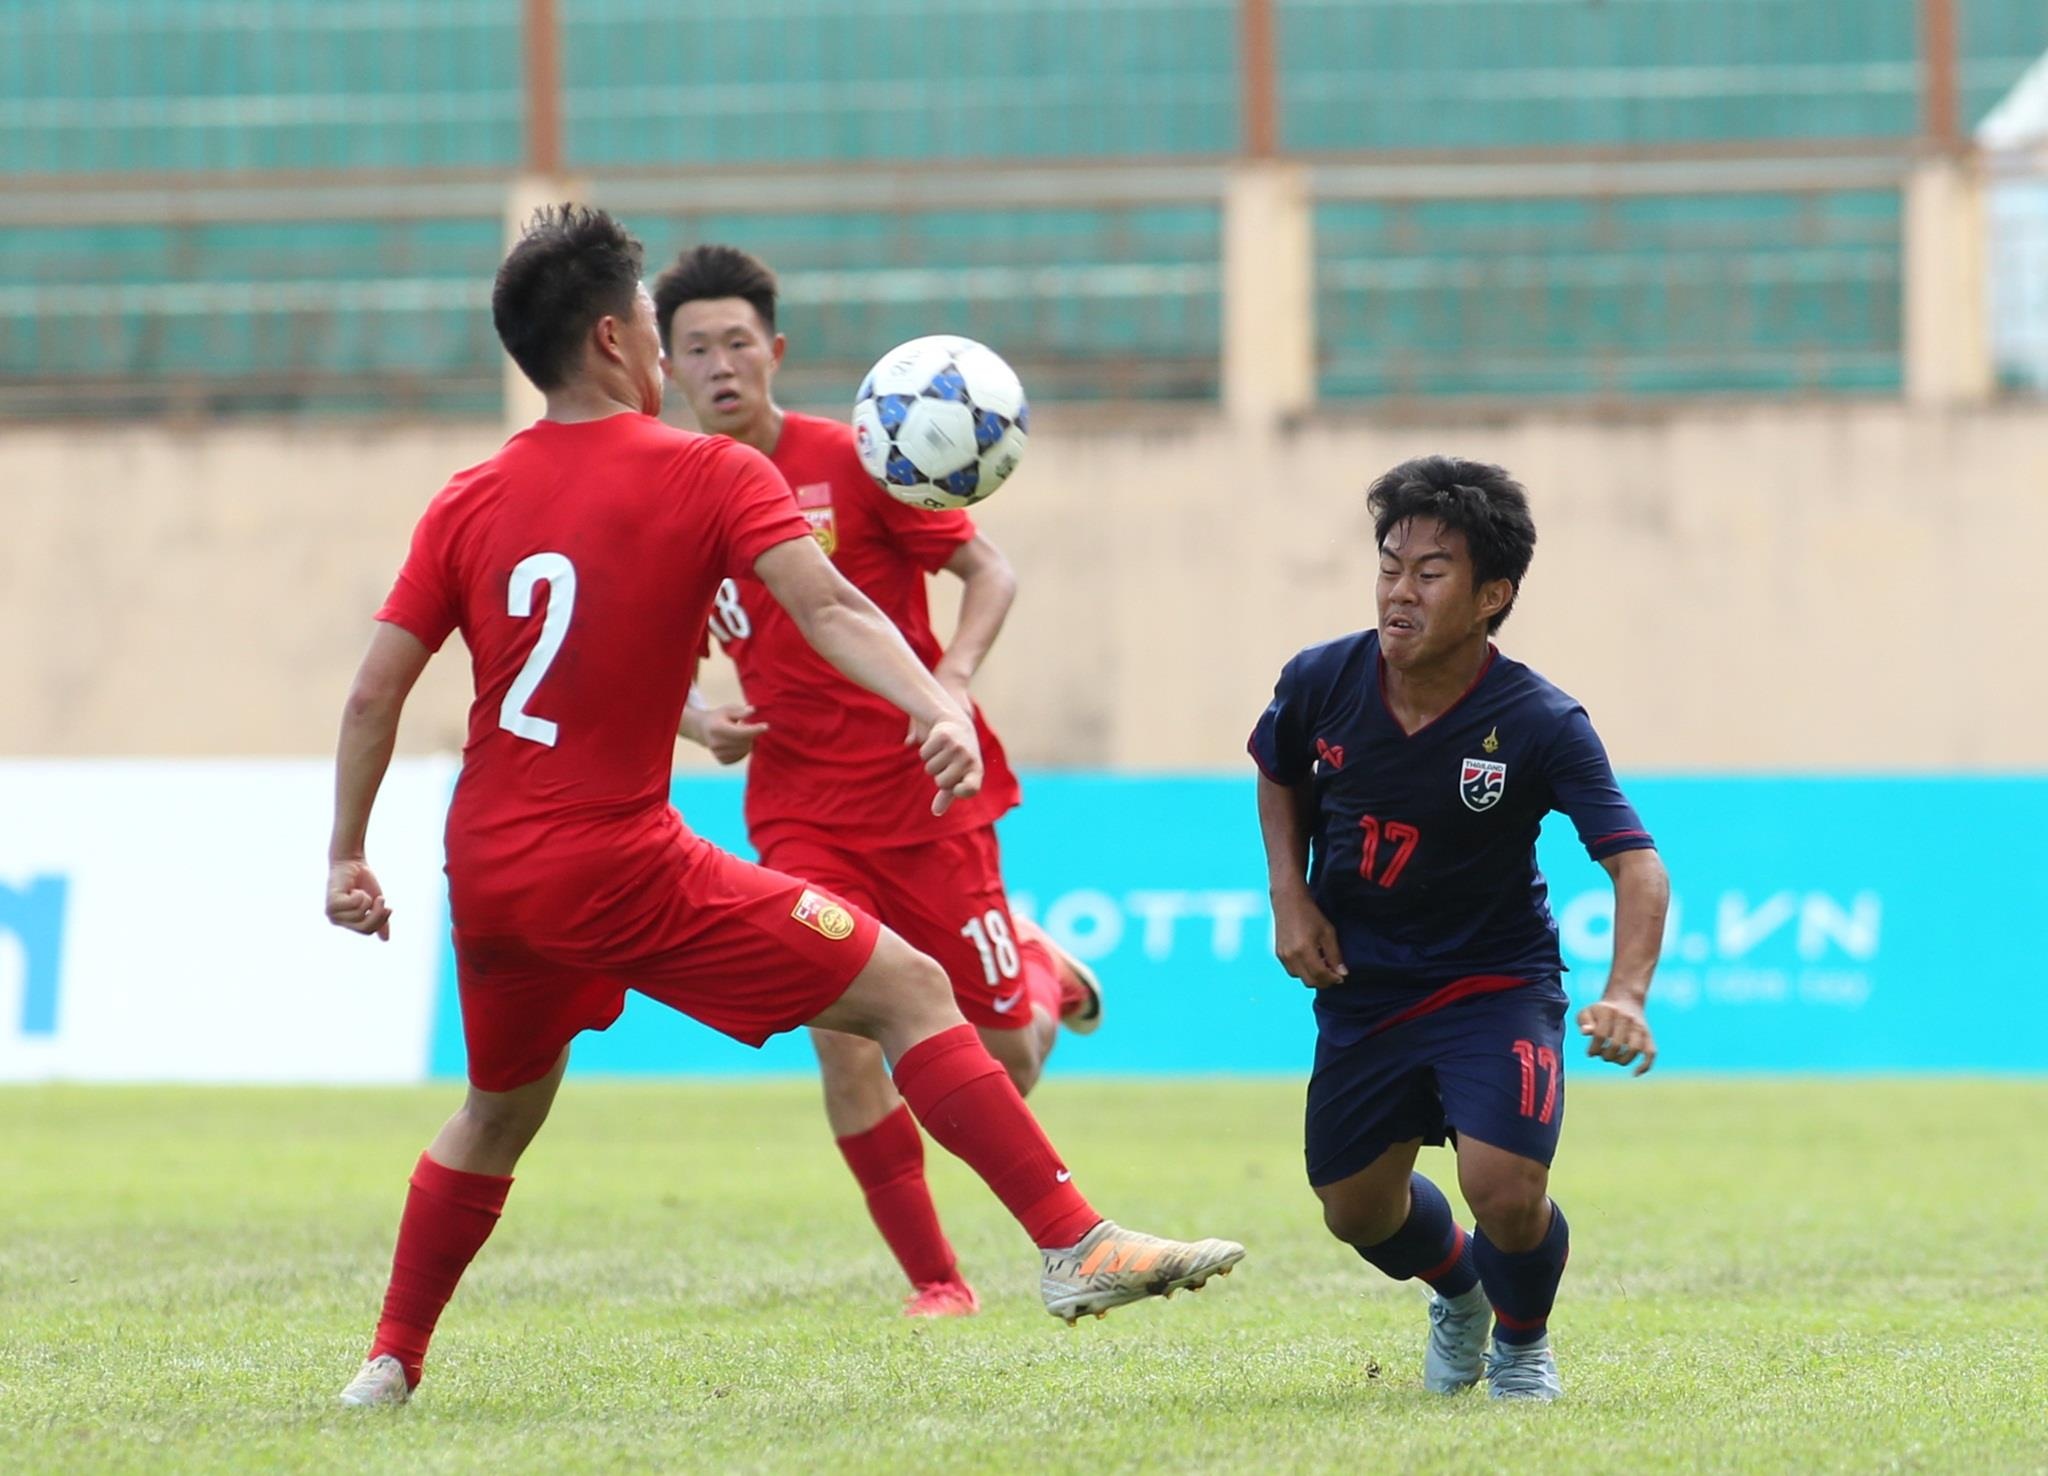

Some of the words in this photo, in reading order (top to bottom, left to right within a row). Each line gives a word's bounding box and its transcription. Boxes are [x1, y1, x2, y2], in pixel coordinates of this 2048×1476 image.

[498, 552, 577, 748] 2
[1465, 760, 1504, 772] THAILAND
[1359, 814, 1420, 888] 17
[960, 909, 1020, 985] 18
[1511, 1039, 1558, 1125] 17
